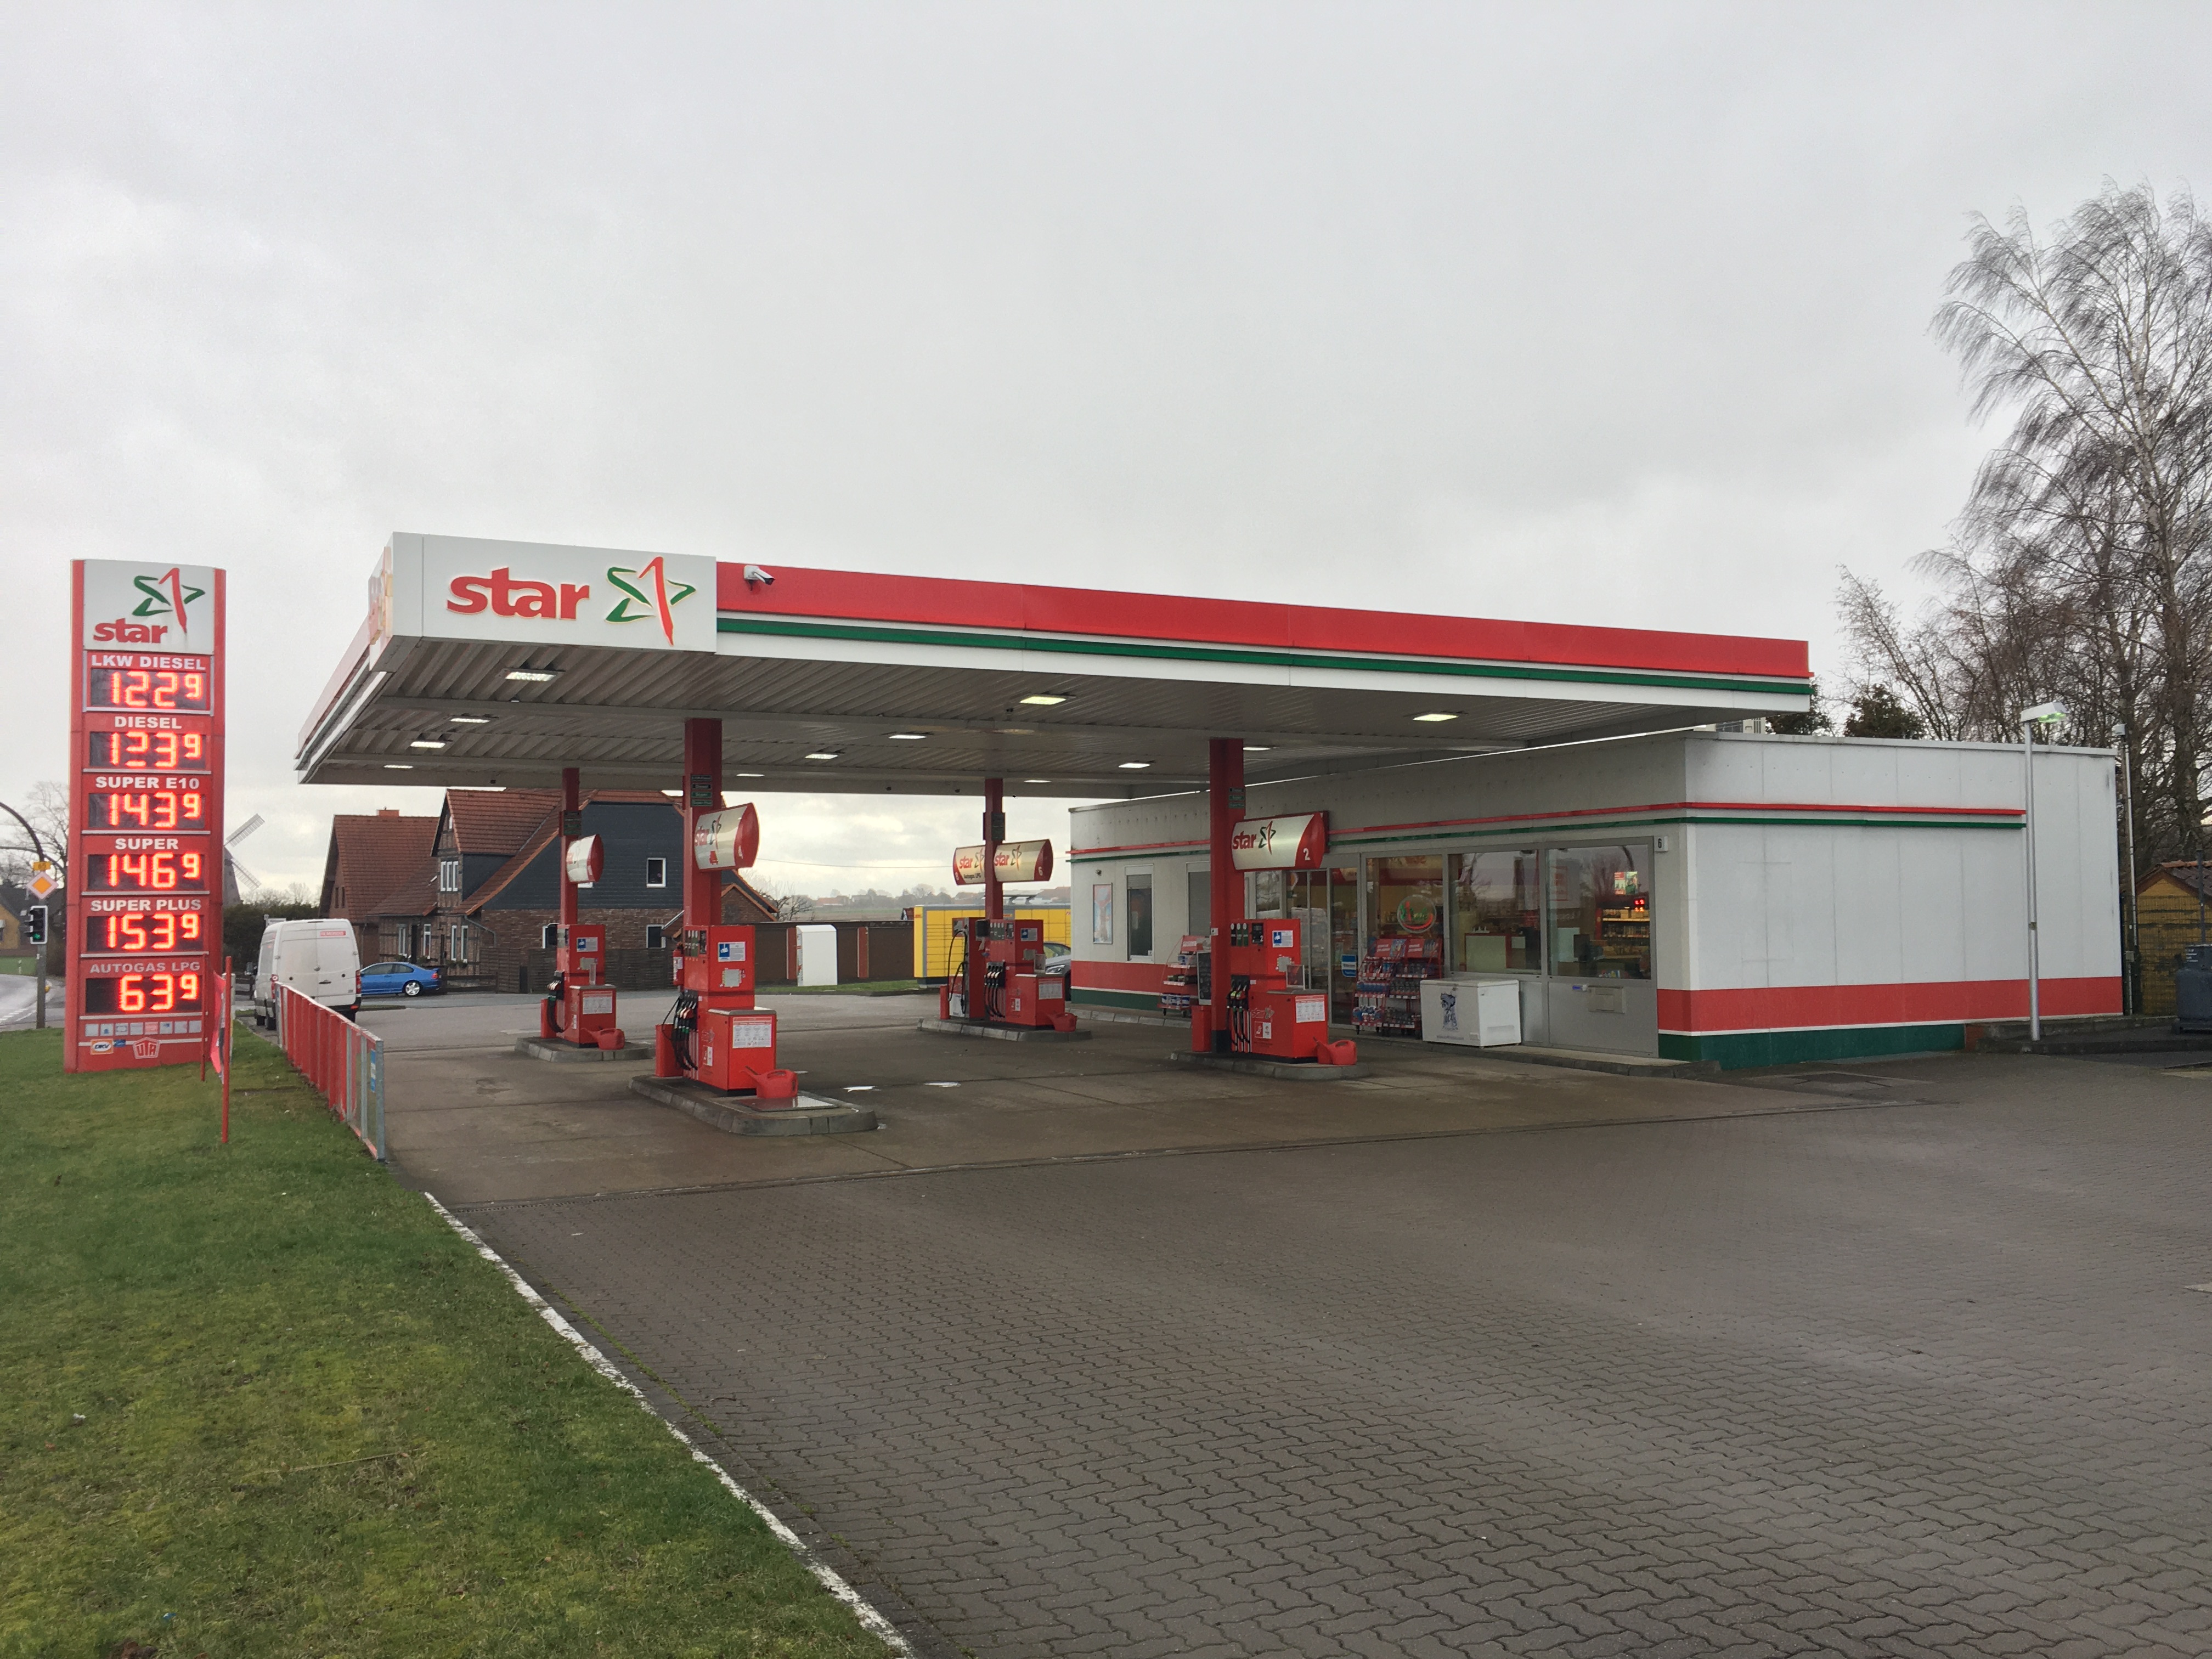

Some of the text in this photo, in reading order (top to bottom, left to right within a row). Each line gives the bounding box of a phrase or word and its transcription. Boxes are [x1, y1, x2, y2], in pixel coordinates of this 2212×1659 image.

[447, 567, 590, 620] star
[93, 618, 168, 644] star
[92, 655, 206, 670] LKW DIESEL
[115, 716, 182, 729] DIESEL
[95, 776, 199, 789] SUPER E10
[115, 838, 178, 850] SUPER
[1232, 831, 1257, 850] star
[1658, 838, 1662, 848] 6
[994, 852, 1009, 866] star
[1303, 848, 1311, 861] 2
[959, 856, 973, 869] star
[91, 899, 201, 912] SUPER PLUS
[90, 961, 201, 974] AUTOGAS LPG
